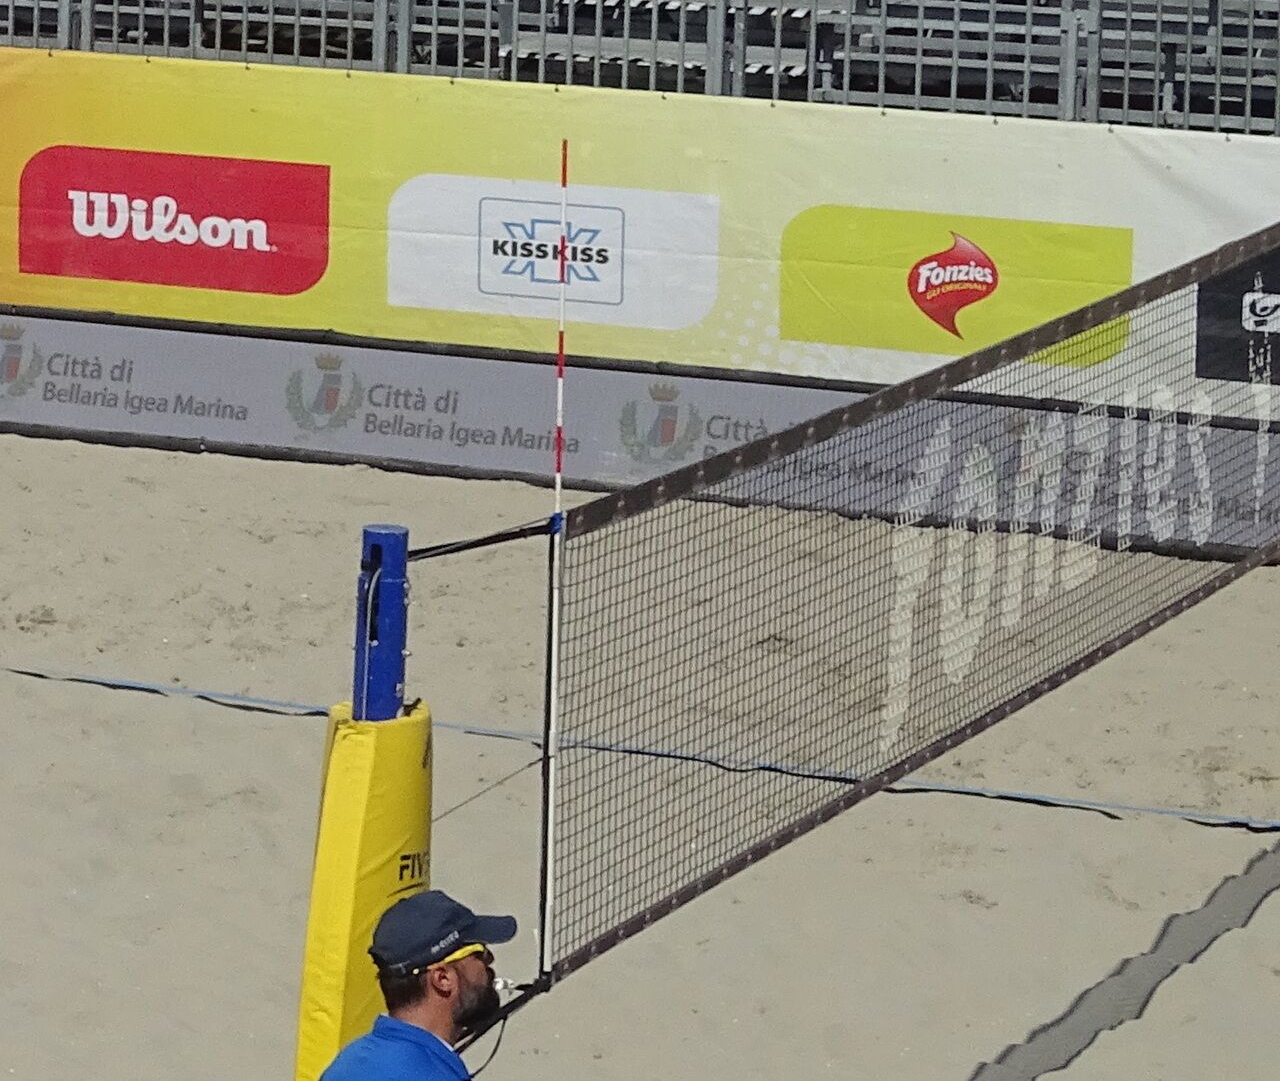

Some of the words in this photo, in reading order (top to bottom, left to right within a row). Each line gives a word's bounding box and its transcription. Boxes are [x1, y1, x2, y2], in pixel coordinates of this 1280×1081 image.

[67, 189, 272, 253] Wilson
[917, 260, 993, 293] Fonzies
[46, 353, 103, 381] Città
[110, 357, 134, 384] di
[42, 381, 119, 409] Bellaria
[124, 389, 168, 416] Igea
[172, 394, 249, 422] Marina
[367, 383, 427, 413] Città
[433, 389, 459, 416] di
[363, 413, 443, 442] Bellaria
[448, 422, 497, 449] Igea
[399, 852, 430, 881] FIV
